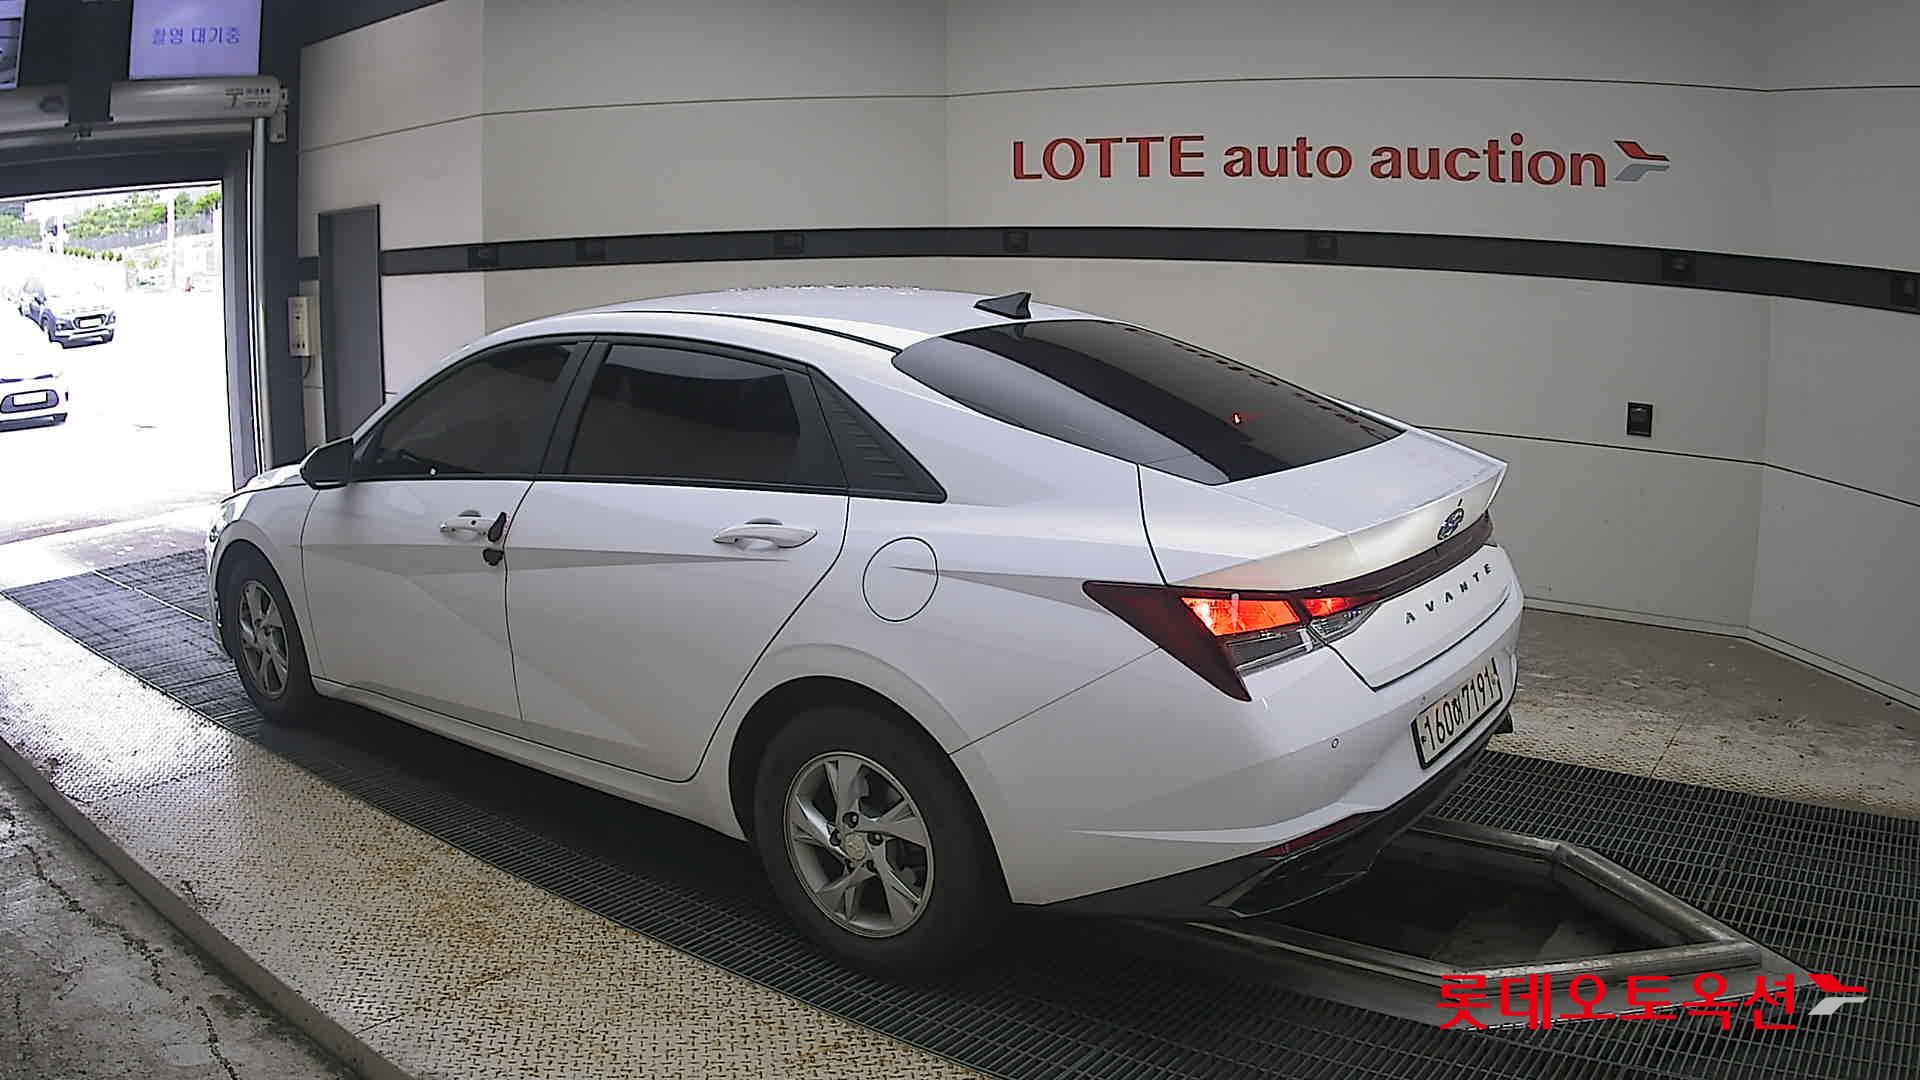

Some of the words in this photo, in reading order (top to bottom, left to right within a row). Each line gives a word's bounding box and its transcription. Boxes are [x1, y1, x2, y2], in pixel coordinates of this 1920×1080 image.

[191, 26, 241, 45] 대기중
[1013, 135, 1205, 181] LOTTE
[1224, 136, 1352, 179] auto
[1371, 133, 1606, 187] auction
[1405, 564, 1493, 624] AVANTE
